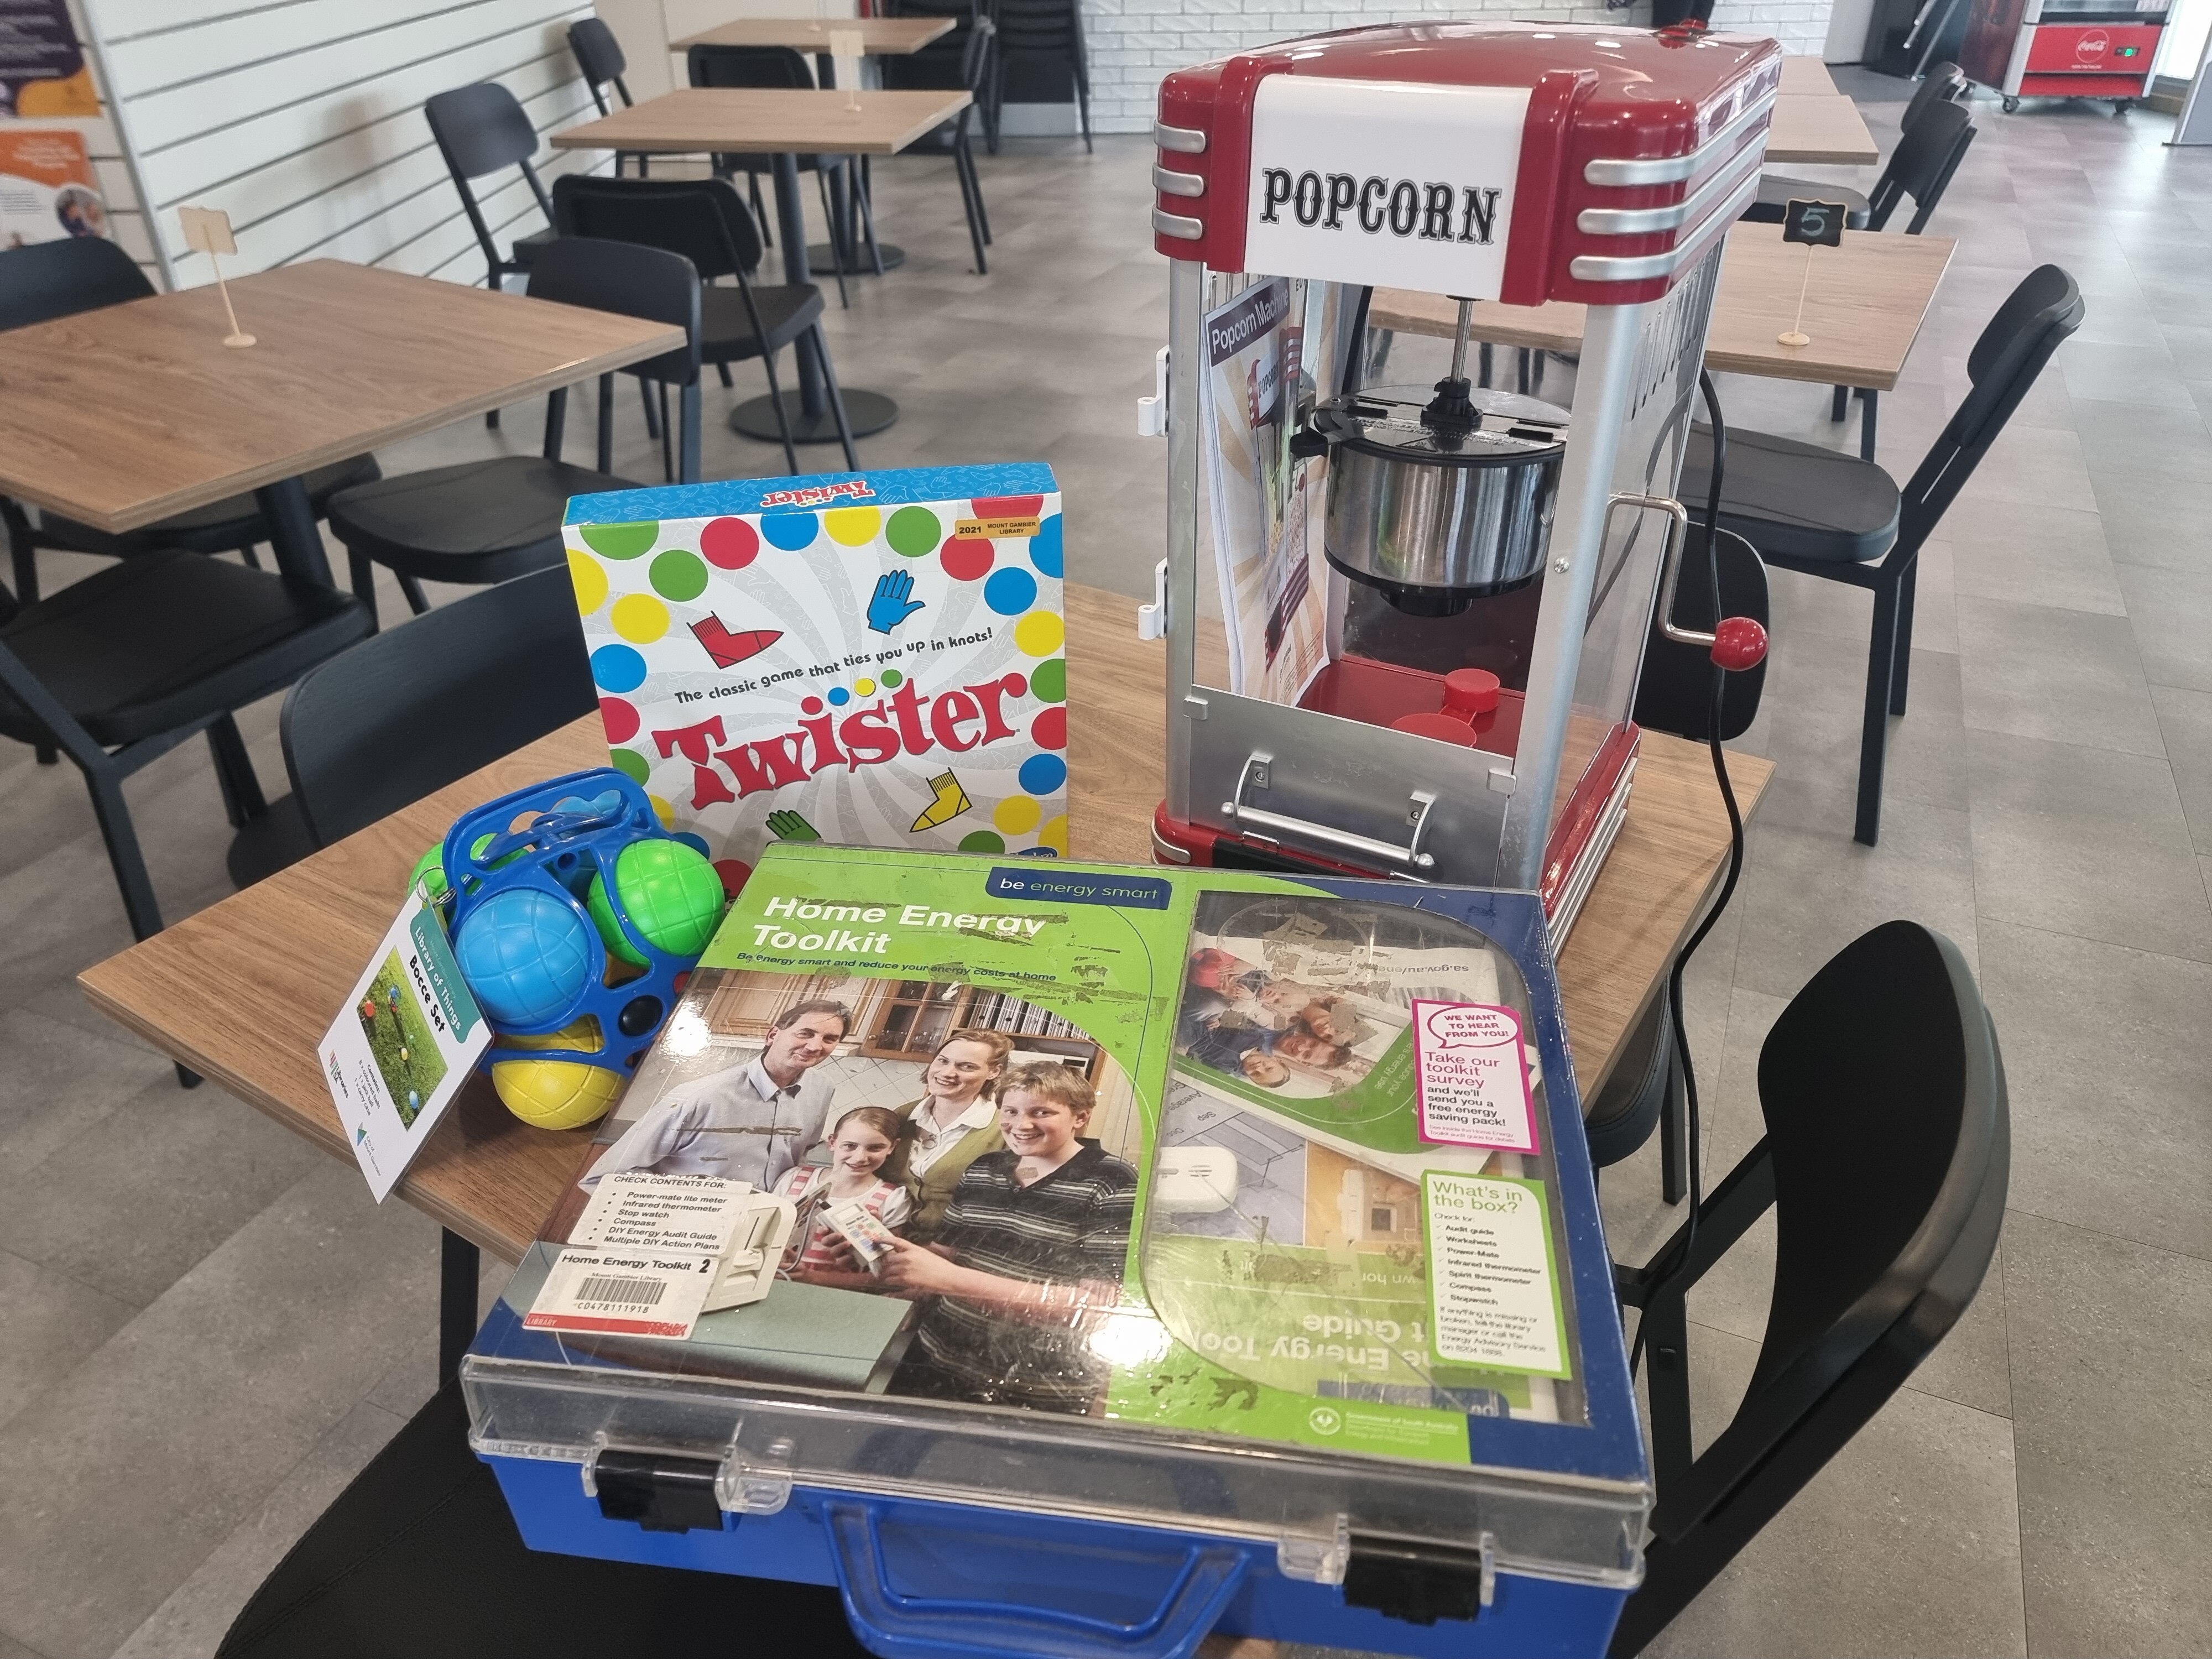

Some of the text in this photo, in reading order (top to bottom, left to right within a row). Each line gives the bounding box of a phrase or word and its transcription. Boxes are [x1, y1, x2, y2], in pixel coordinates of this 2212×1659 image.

[1260, 168, 1501, 244] POPCORN
[1801, 207, 1830, 236] 5
[1212, 289, 1289, 354] Popcorn Machine
[761, 482, 874, 506] Twister
[675, 627, 993, 703] The classic game that ties you up in knots!
[651, 672, 1027, 811] Twister
[1000, 878, 1158, 899] be energy smart
[763, 896, 1048, 940] Home Energy
[753, 925, 891, 954] Toolkit
[737, 952, 753, 962] Be
[757, 954, 796, 966] energy
[930, 965, 971, 975] energy
[973, 968, 1005, 977] costs
[1023, 972, 1057, 981] home
[415, 926, 461, 1030] Library of Things
[410, 955, 445, 1032] Bocce Set
[1425, 1051, 1500, 1068] Take our
[1426, 1062, 1480, 1076] toolkit
[336, 1066, 349, 1098] Libraries
[1427, 1075, 1485, 1089] survey
[1168, 1091, 1202, 1110] Average
[1428, 1095, 1457, 1104] send
[1461, 1098, 1483, 1107] you
[1197, 1111, 1217, 1121] Sep
[1428, 1103, 1452, 1112] free
[1455, 1107, 1498, 1118] energy
[1429, 1113, 1506, 1126] saving pack!
[650, 1178, 702, 1187] CONTENTS
[627, 1191, 681, 1202] Power-mate
[1433, 1181, 1522, 1202] What's in
[623, 1201, 722, 1213] Infrared thermometer
[1434, 1194, 1518, 1214] the box?
[618, 1209, 639, 1217] Stop
[613, 1218, 656, 1227] Compass
[1446, 1224, 1468, 1233] Audit
[604, 1236, 640, 1245] Multiple
[661, 1240, 692, 1249] Action
[627, 1229, 661, 1238] Energy
[690, 1232, 717, 1240] Guide
[1446, 1235, 1498, 1246] Worksheets
[562, 1255, 711, 1273] Home Energy Toolkit 2
[1448, 1259, 1541, 1274] Infrared thermometer
[1449, 1282, 1492, 1292] Compass
[1474, 1274, 1531, 1284] thermometer
[1451, 1295, 1499, 1306] Stopwatch
[526, 1317, 557, 1327] LIBRARY
[1303, 1312, 1401, 1343] Guide
[1271, 1336, 1389, 1371] Energy
